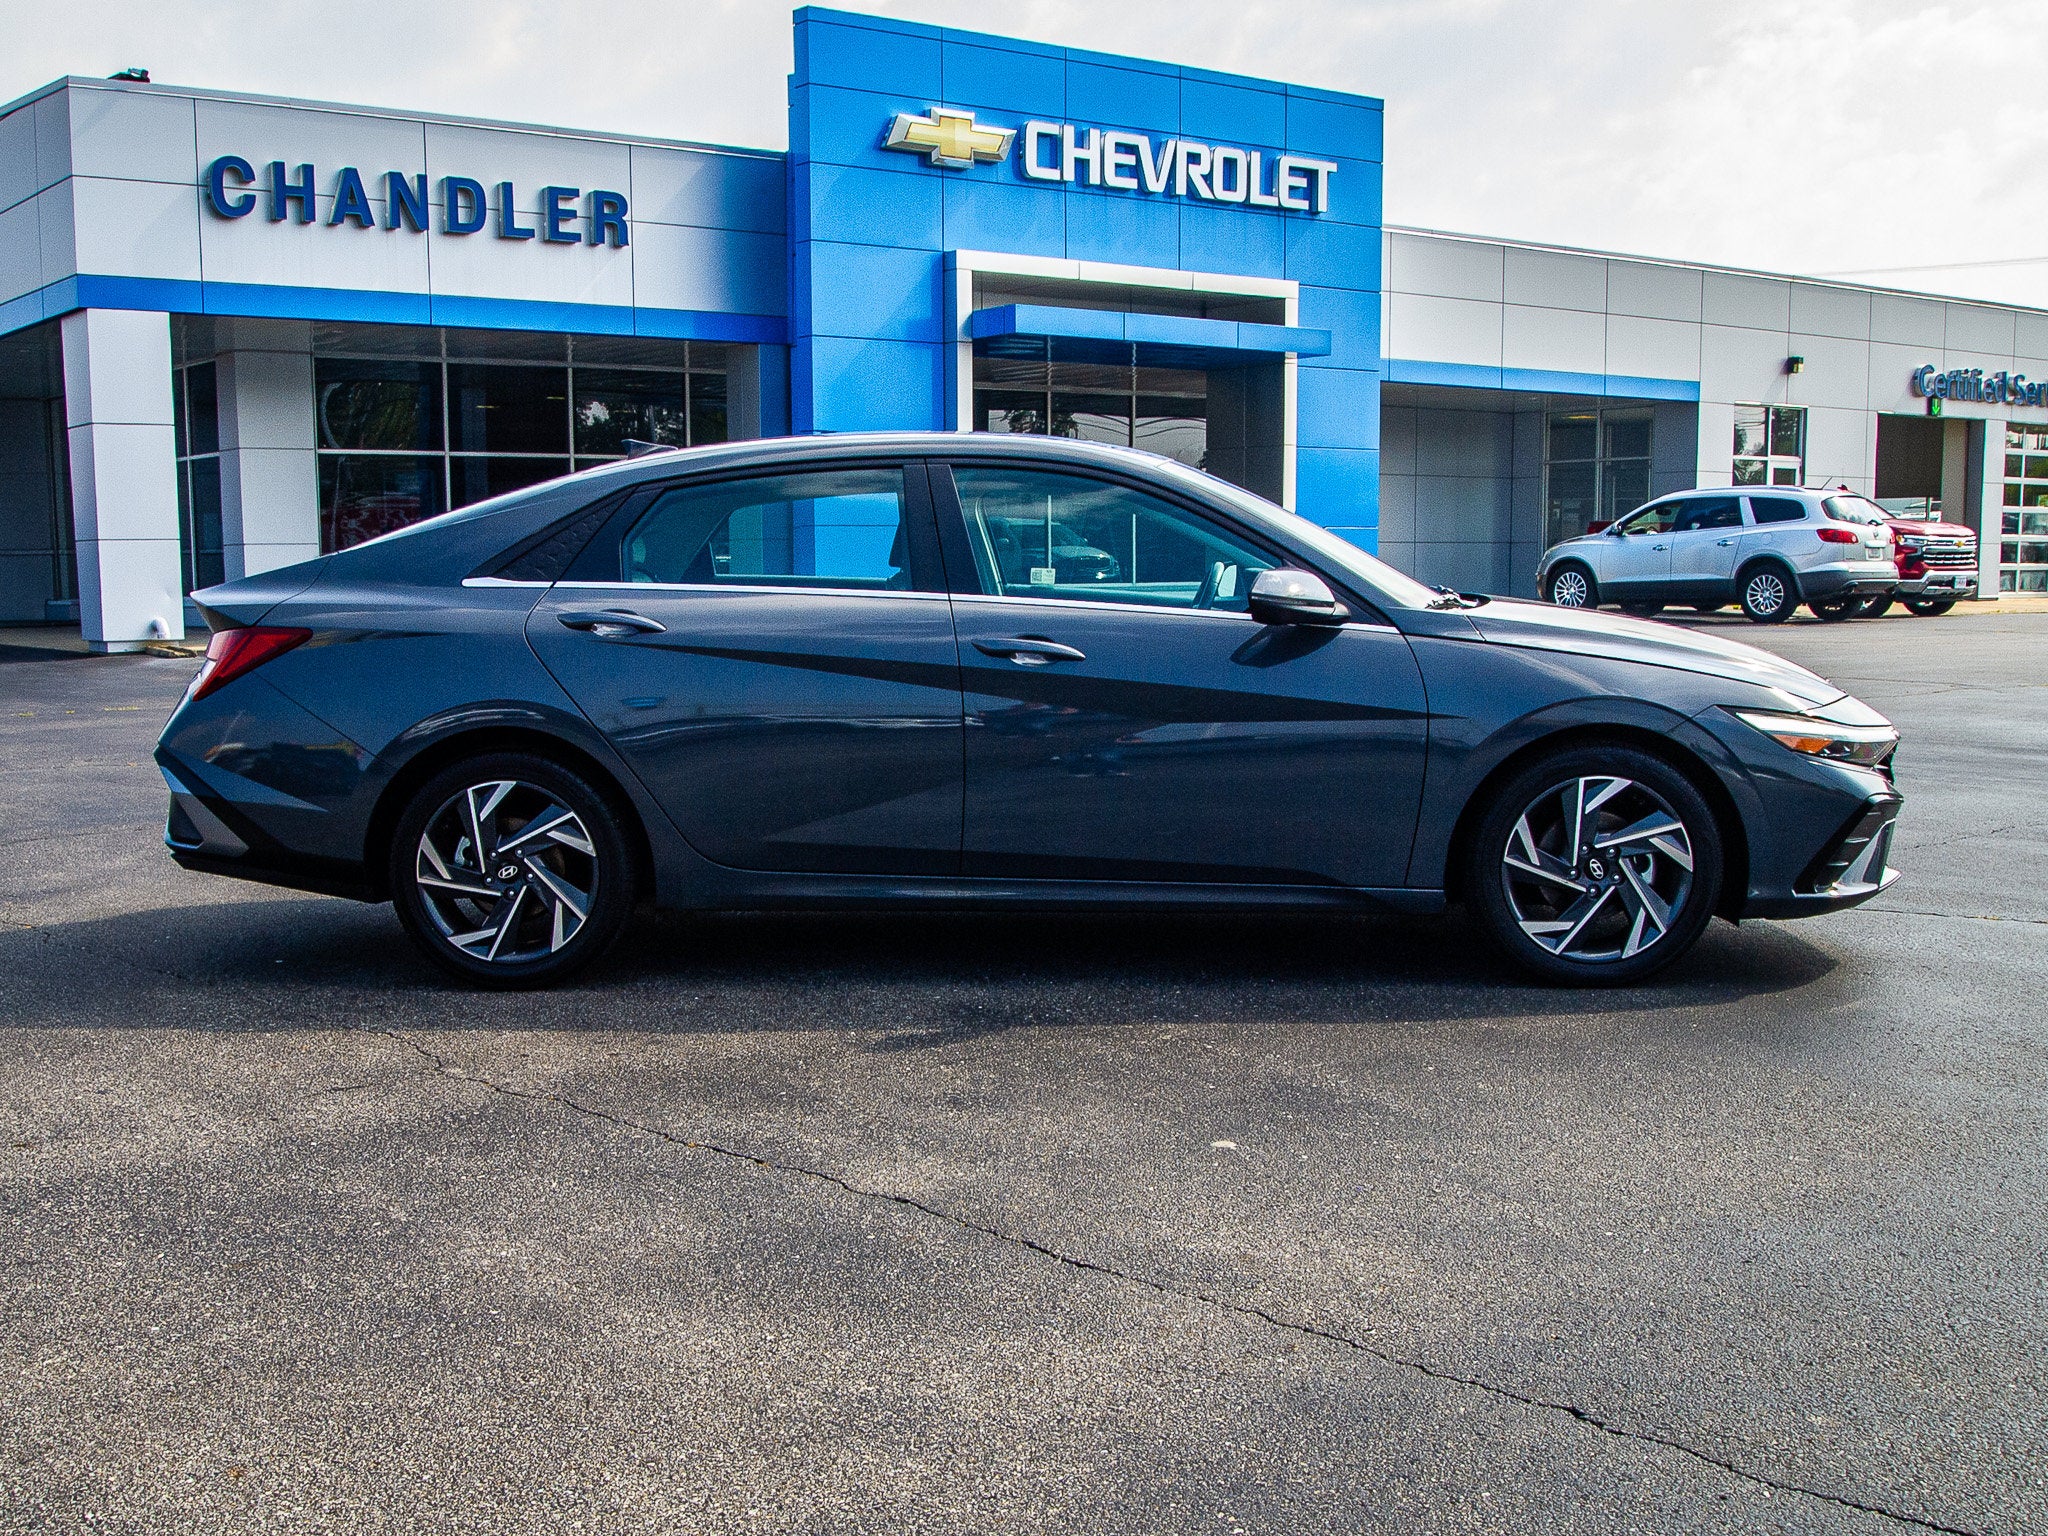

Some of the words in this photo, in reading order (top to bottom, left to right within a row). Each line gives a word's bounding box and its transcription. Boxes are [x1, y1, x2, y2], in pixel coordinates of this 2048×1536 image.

[207, 155, 630, 247] CHANDLER
[1022, 119, 1338, 213] CHEVROLET
[1914, 364, 2008, 403] Certified
[2013, 374, 2048, 406] Ser
